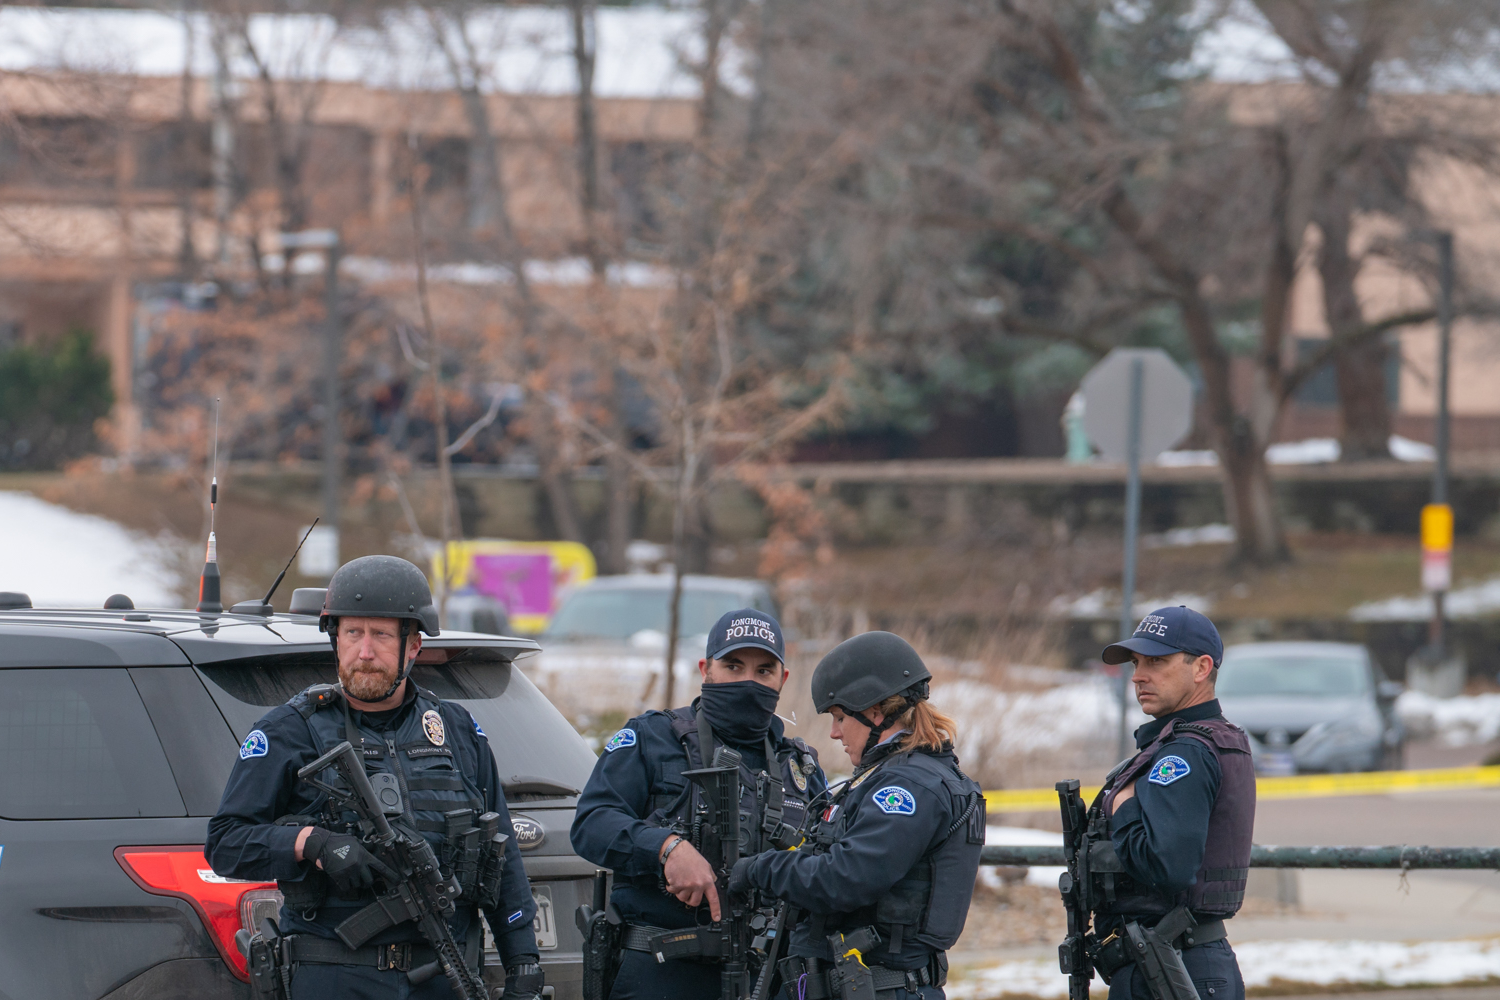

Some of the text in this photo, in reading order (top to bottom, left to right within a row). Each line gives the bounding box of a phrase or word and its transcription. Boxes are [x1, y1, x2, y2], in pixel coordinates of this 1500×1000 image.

[731, 617, 770, 630] LONGMONT
[726, 625, 776, 644] POLICE
[513, 822, 537, 840] Ford
